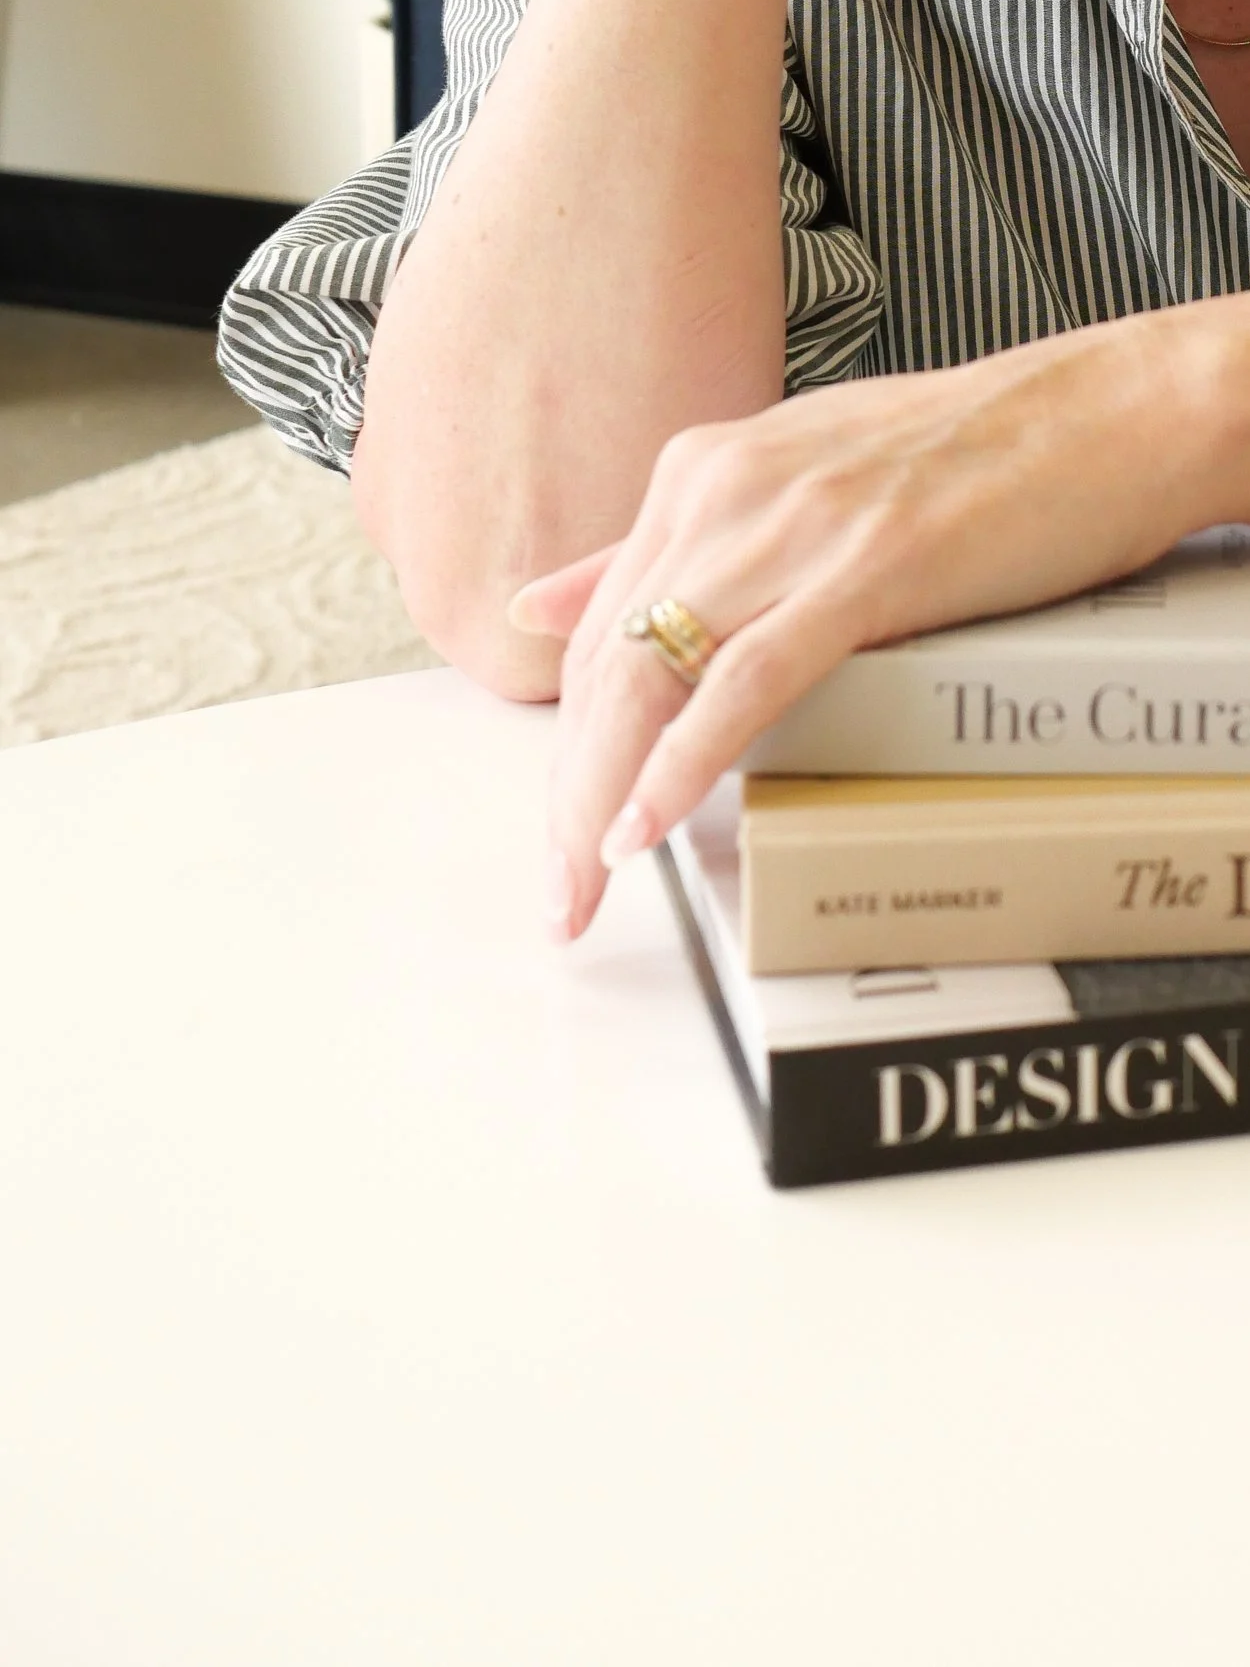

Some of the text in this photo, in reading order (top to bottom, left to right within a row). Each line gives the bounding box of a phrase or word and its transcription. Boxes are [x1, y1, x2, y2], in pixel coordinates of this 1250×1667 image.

[934, 680, 1067, 745] The
[814, 886, 1003, 918] KATE MARKER
[1115, 854, 1208, 911] The
[873, 1028, 1241, 1147] DESIGN
